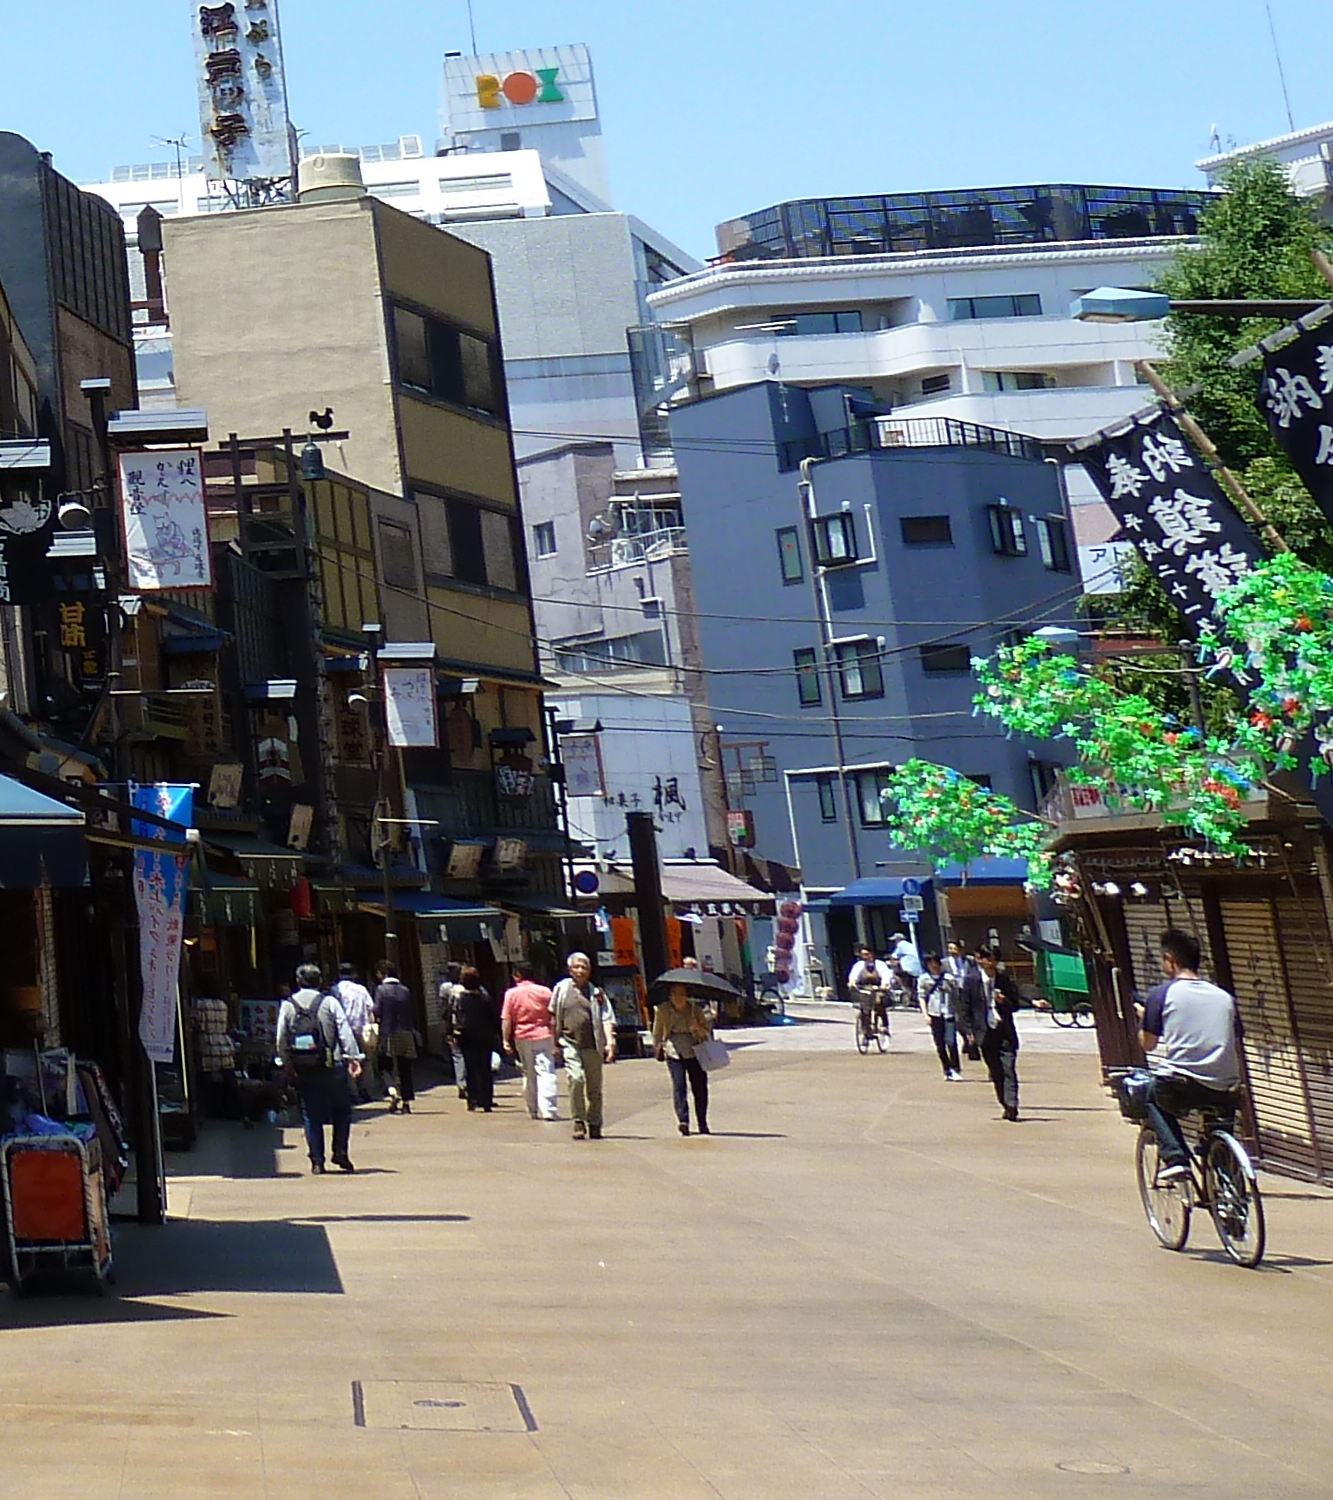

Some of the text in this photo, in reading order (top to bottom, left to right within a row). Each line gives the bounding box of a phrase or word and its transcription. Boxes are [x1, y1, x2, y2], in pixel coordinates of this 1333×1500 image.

[476, 68, 564, 108] ROX
[603, 792, 641, 808] 和菓子
[651, 776, 686, 811] 楓
